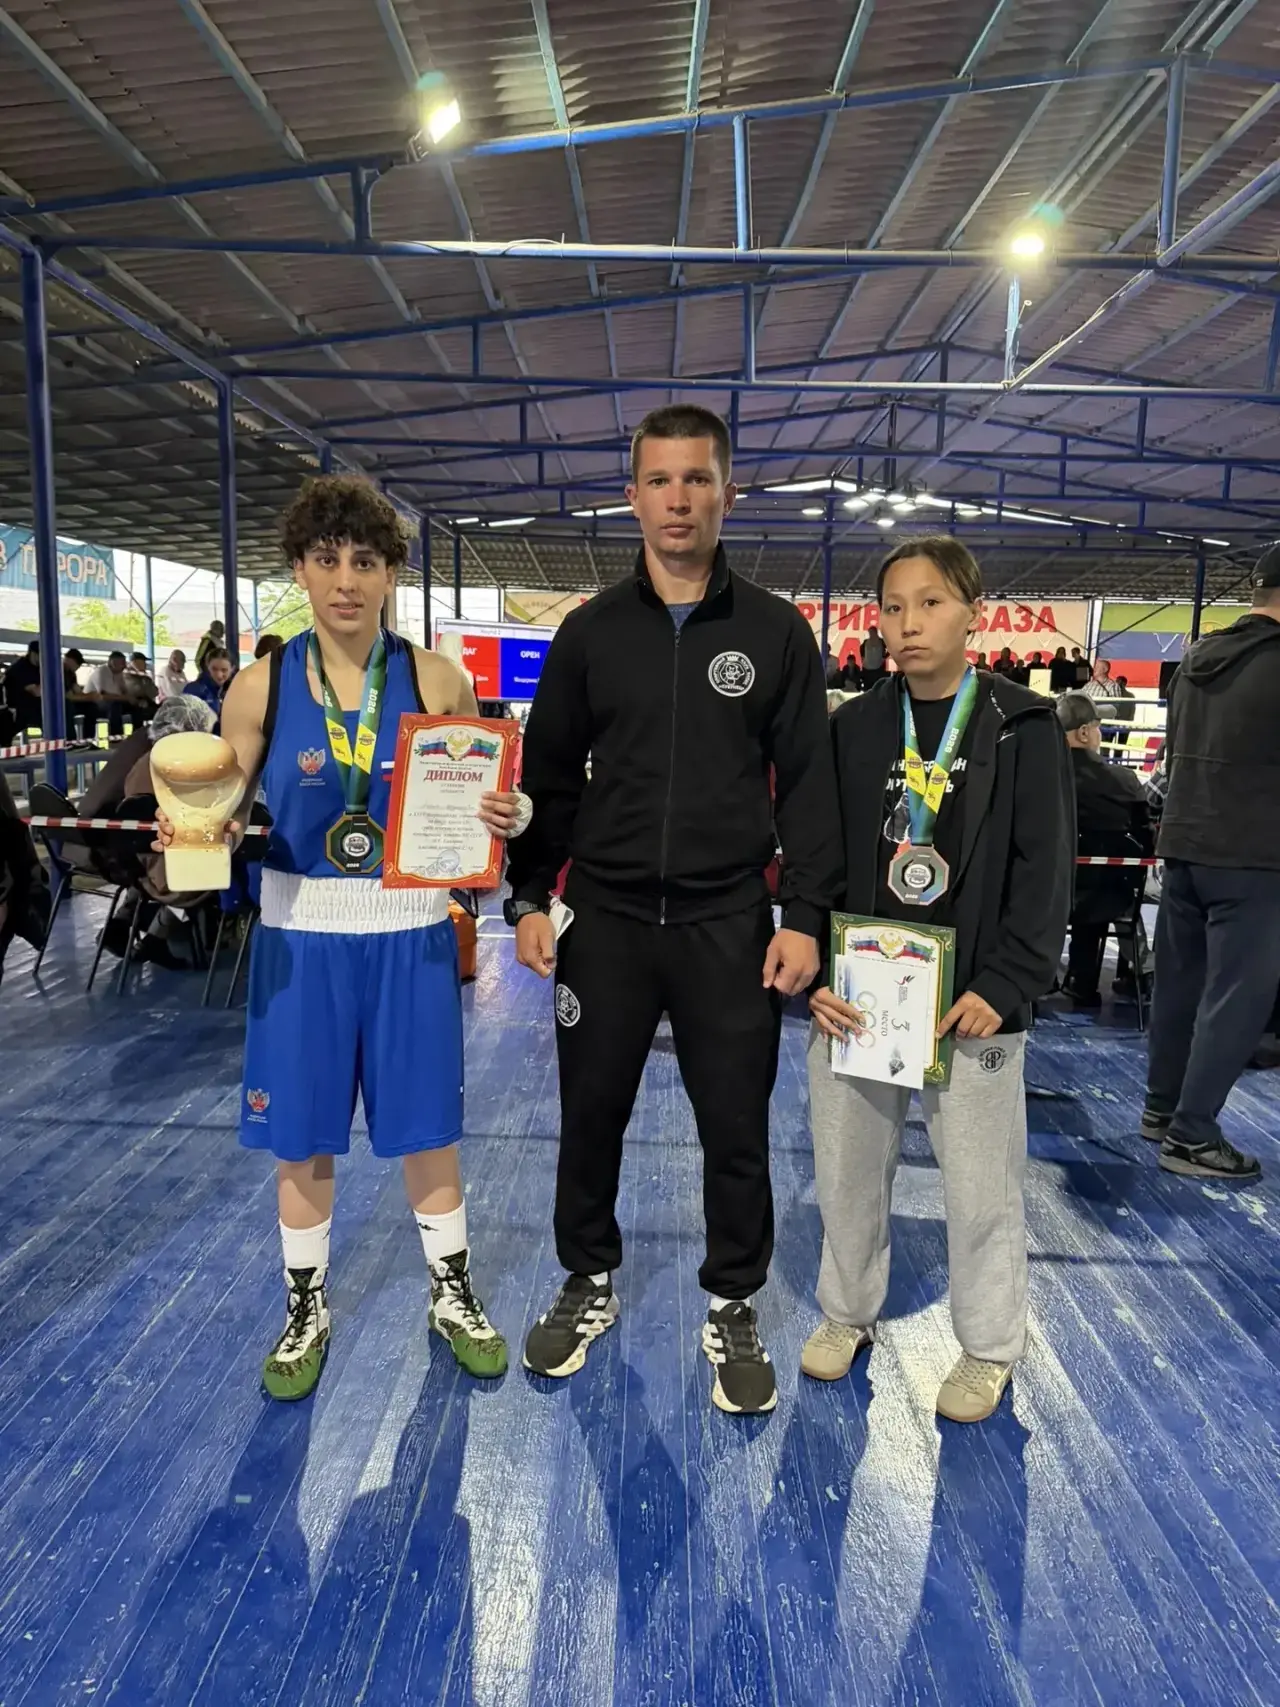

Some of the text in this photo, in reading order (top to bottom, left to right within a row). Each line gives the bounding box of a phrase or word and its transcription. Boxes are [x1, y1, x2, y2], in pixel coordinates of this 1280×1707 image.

[366, 687, 378, 714] 2026
[423, 769, 484, 783] ДИПЛОМ
[891, 1017, 911, 1033] 3
